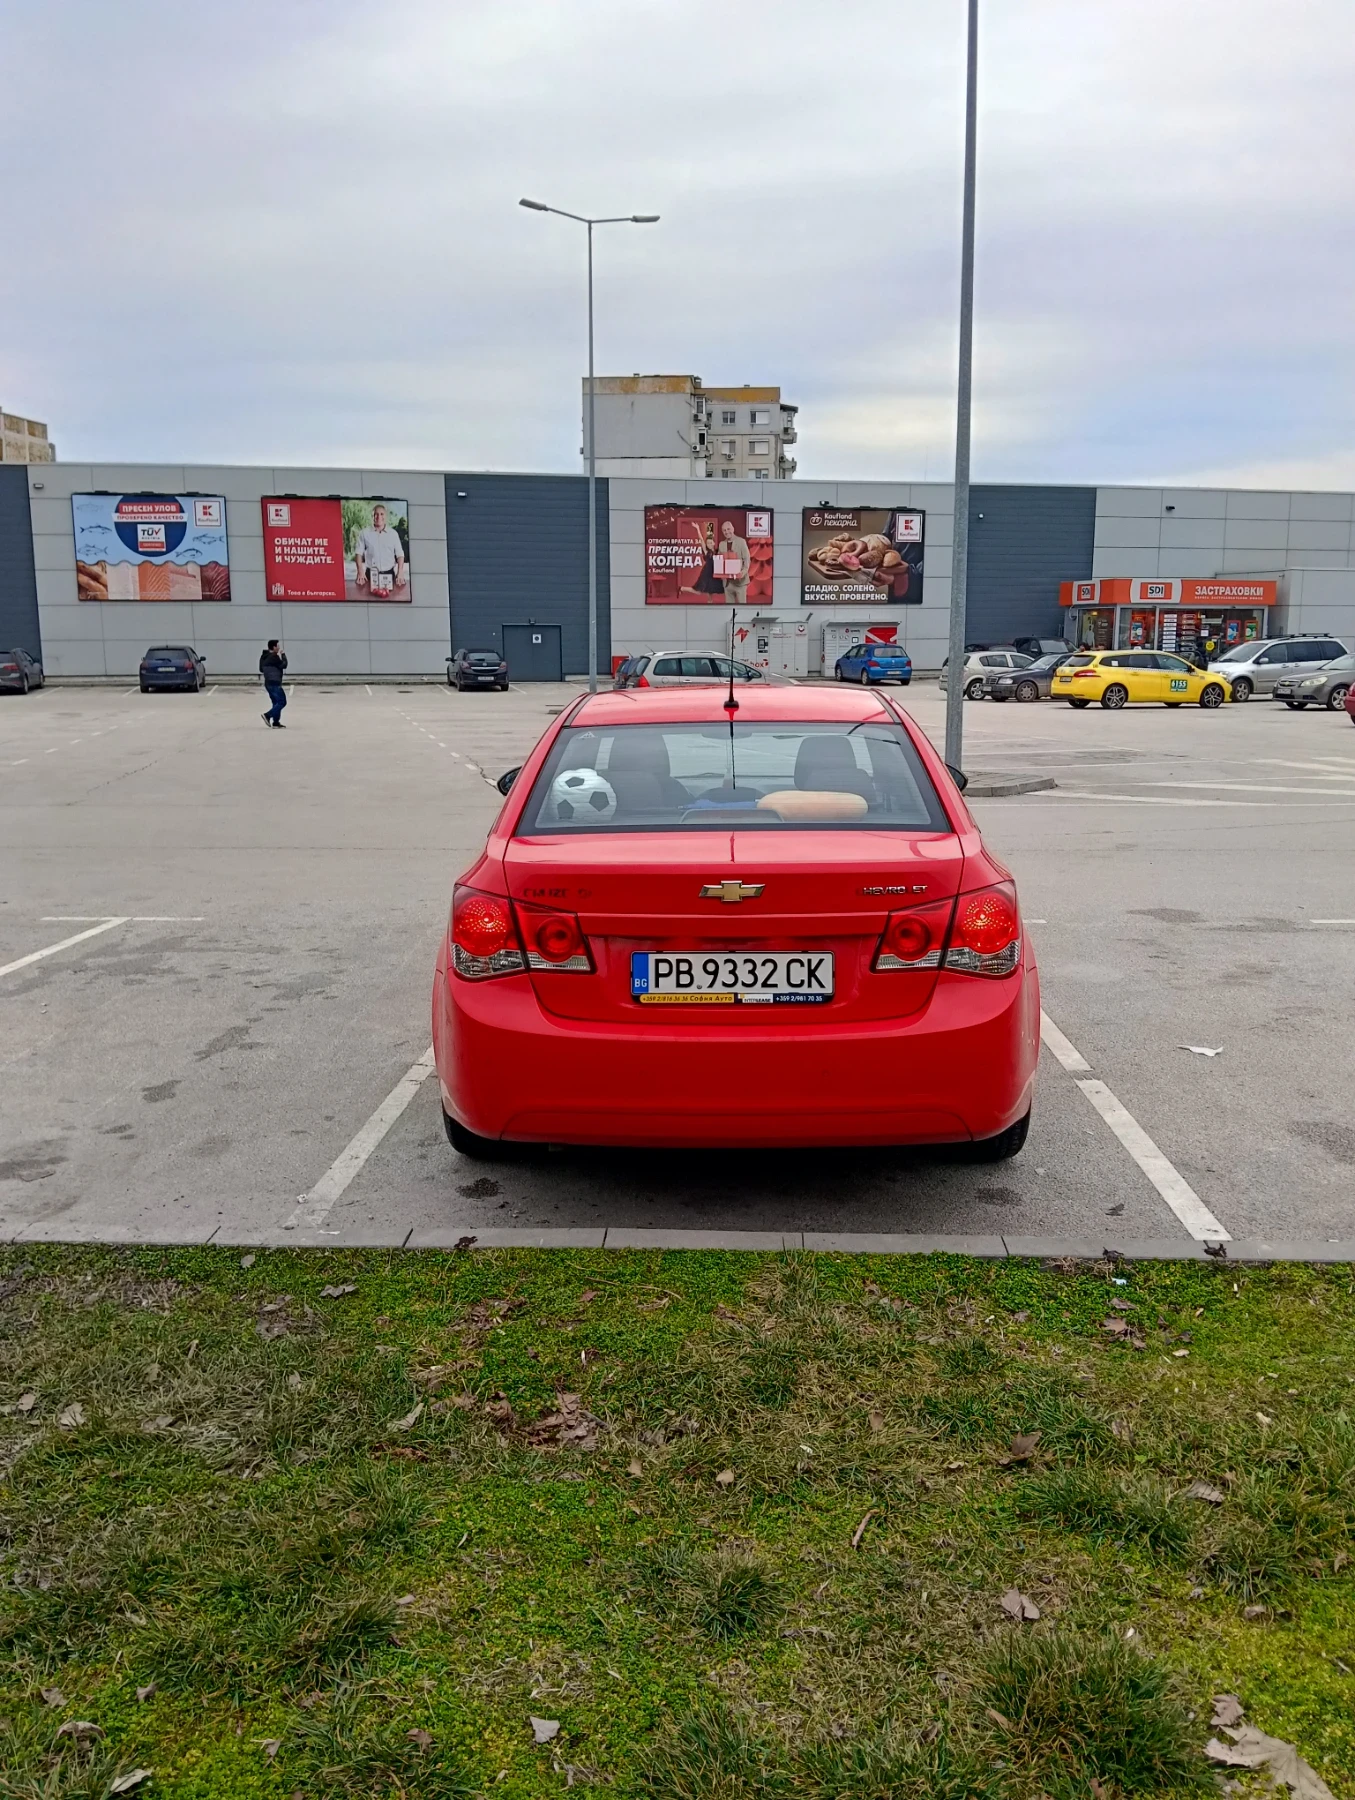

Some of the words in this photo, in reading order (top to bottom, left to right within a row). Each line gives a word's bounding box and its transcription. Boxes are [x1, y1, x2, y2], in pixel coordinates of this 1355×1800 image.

[154, 504, 176, 512] УЛОВ
[274, 537, 312, 546] ОБИЧАТ
[314, 538, 329, 546] МЕ
[275, 546, 282, 554] И
[284, 546, 328, 556] НАШИТЕ,
[648, 546, 702, 554] ПРЕКРАСНА
[275, 555, 282, 563] И
[284, 556, 335, 565] ЧУЖДИТЕ.
[648, 556, 703, 568] КОЛЕДА
[804, 585, 841, 593] СЛАДКО.
[1148, 585, 1164, 595] SDI
[1195, 586, 1264, 596] ЗАСТРАХОВКИ
[839, 593, 888, 601] ПРОВЕРЕНО.
[1171, 680, 1187, 688] 6155
[634, 978, 648, 988] BG
